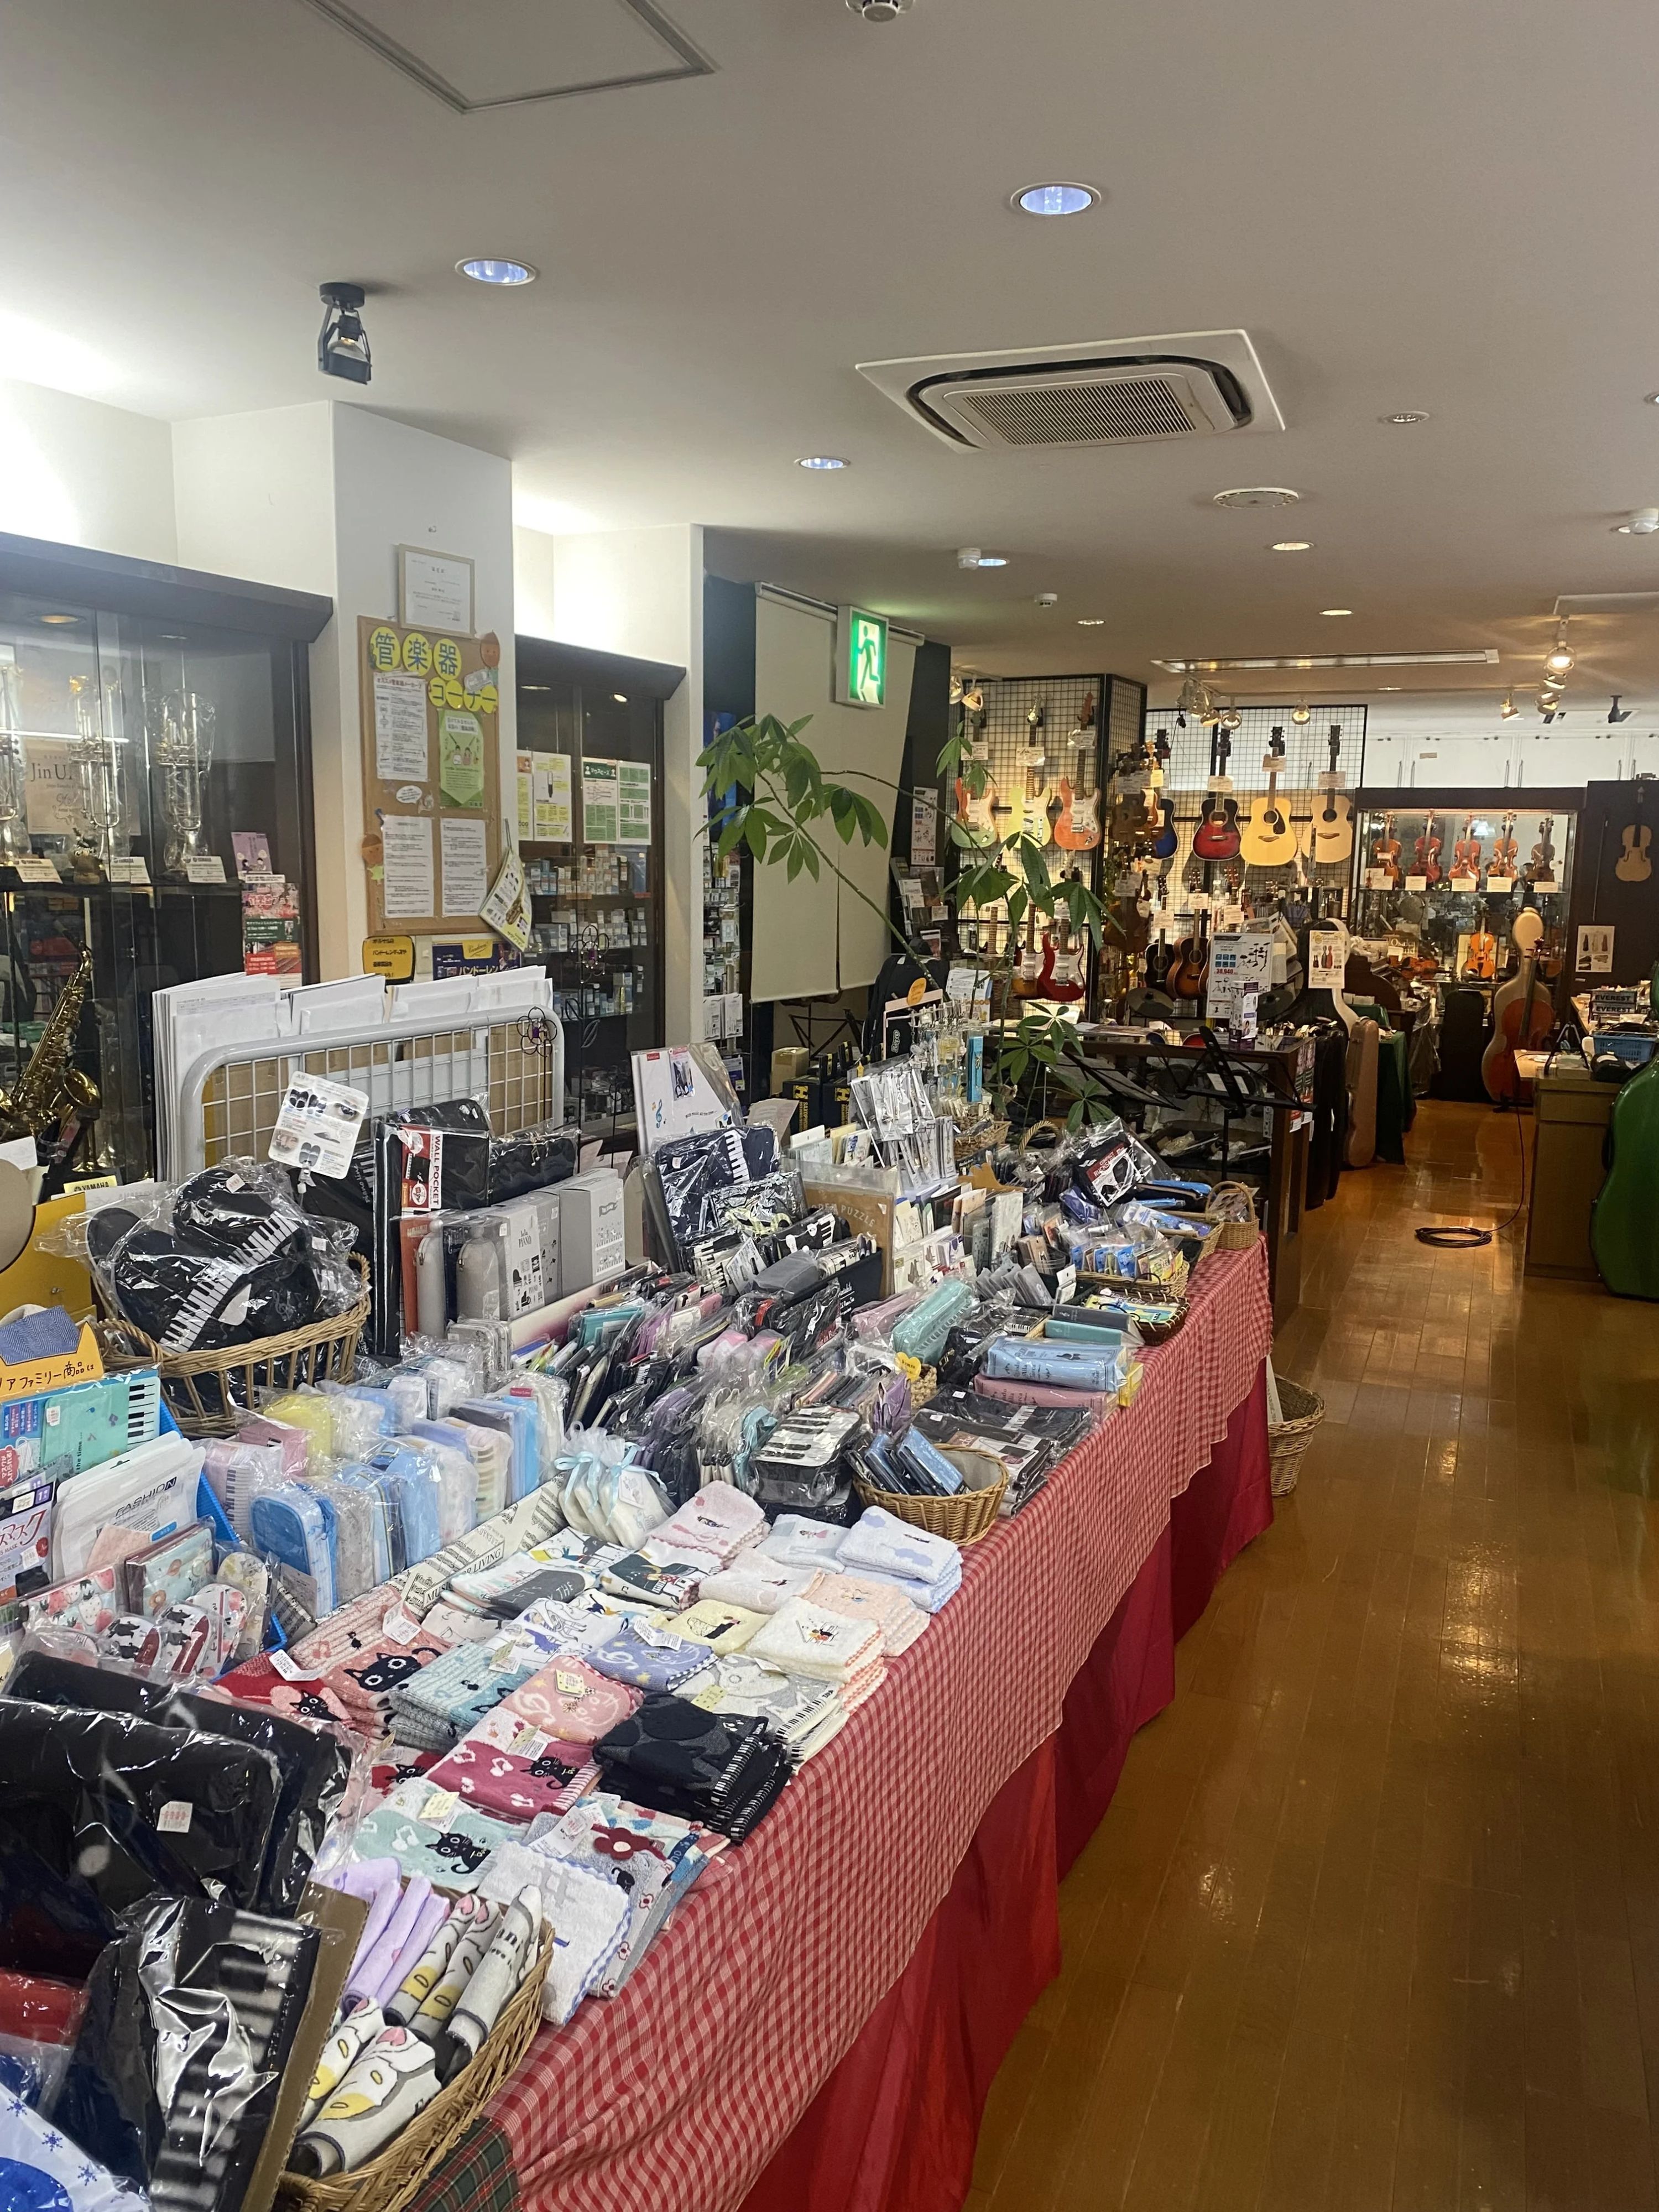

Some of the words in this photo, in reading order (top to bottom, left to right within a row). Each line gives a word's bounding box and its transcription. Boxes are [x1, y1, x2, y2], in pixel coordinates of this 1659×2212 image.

[374, 632, 459, 676] 管楽器
[432, 684, 497, 708] コーナー
[30, 763, 51, 781] Jin
[82, 1181, 109, 1191] YAMAHA
[841, 1206, 876, 1228] PUZZLE
[518, 1235, 532, 1248] PIANO
[115, 1476, 177, 1517] FASHION
[473, 1548, 502, 1574] LIVING
[555, 1580, 575, 1600] THE
